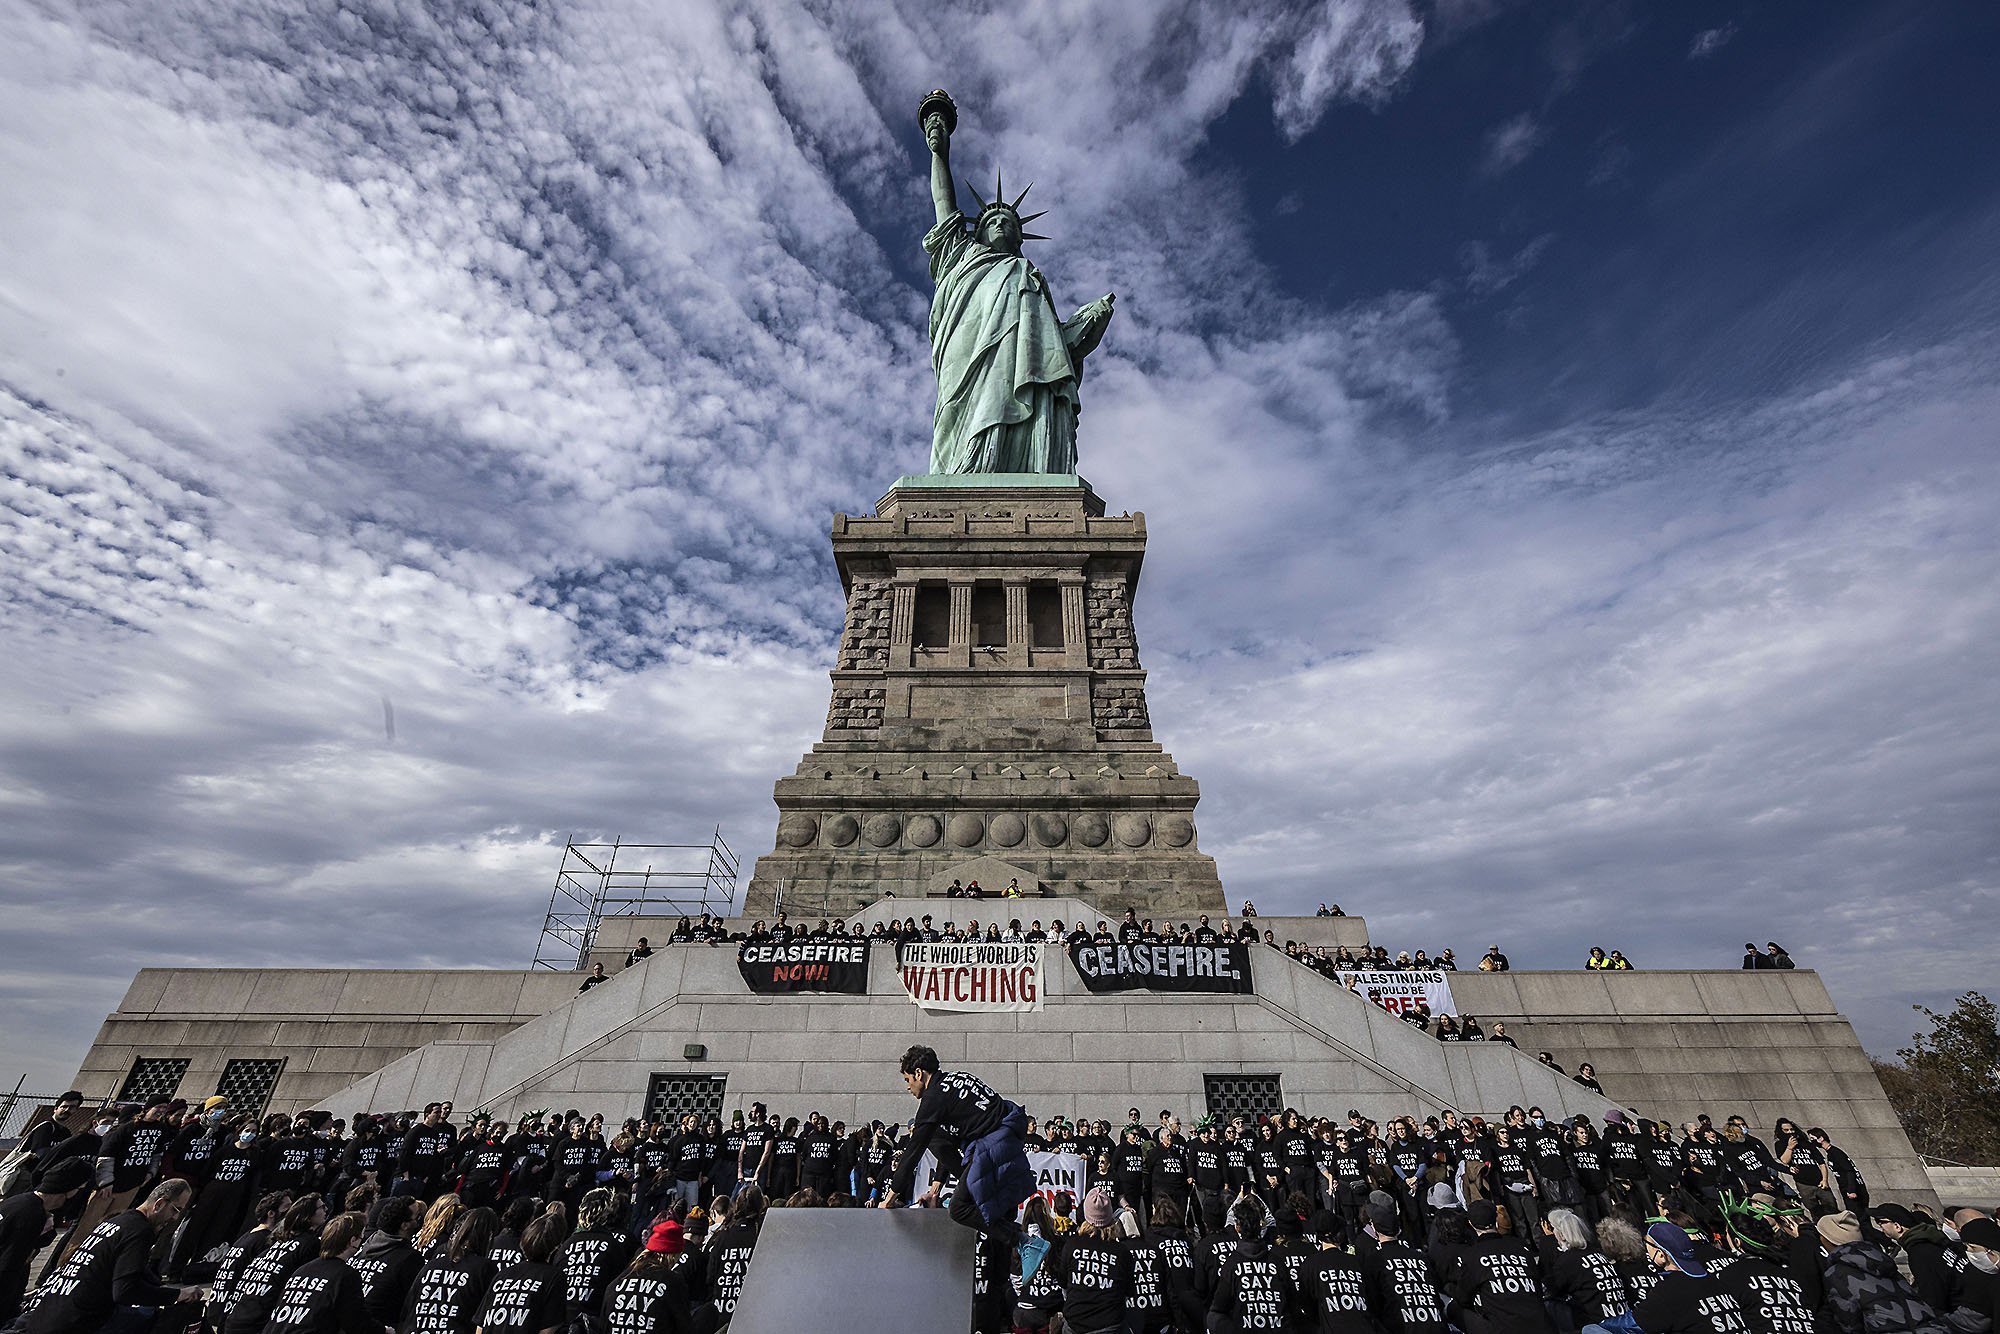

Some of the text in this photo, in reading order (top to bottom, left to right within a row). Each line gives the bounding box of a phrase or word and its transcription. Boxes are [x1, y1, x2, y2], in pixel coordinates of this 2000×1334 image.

[744, 945, 864, 963] CEASEFIRE
[905, 945, 1036, 964] THE WHOLE WORLD IS
[1078, 944, 1241, 980] CEASEFIRE.
[774, 965, 829, 982] NOW!
[1350, 972, 1443, 984] ALESTINIANS
[903, 966, 1036, 1003] WATCHING
[1412, 986, 1424, 994] BE
[133, 1129, 162, 1138] JEWS
[564, 1240, 609, 1255] JEWS
[721, 1248, 752, 1260] JEW
[1211, 1241, 1237, 1254] JEW
[567, 1252, 600, 1265] SAY
[1072, 1249, 1117, 1265] CEASE
[1480, 1255, 1528, 1266] CEASE
[1078, 1260, 1108, 1275] FIRE
[1134, 1260, 1153, 1272] AY
[1234, 1262, 1277, 1276] JEWS
[1386, 1258, 1428, 1271] JEWS
[1492, 1266, 1527, 1277] FIRE
[1592, 1264, 1617, 1279] SAY
[421, 1270, 469, 1287] JEWS
[1072, 1272, 1113, 1289] NOW
[1241, 1275, 1273, 1289] SAY
[1320, 1269, 1363, 1283] CEASE
[1395, 1270, 1426, 1282] SAY
[492, 1278, 542, 1293] CEASE
[615, 1278, 667, 1297] JEWS
[1136, 1284, 1155, 1294] IRE
[1329, 1282, 1359, 1295] FIRE
[1394, 1283, 1436, 1295] CEASE
[1489, 1278, 1536, 1294] NOW
[1748, 1276, 1802, 1293] JEWS
[420, 1285, 457, 1303] SAY
[492, 1293, 528, 1306] FIRE
[566, 1287, 594, 1301] OW
[721, 1287, 741, 1298] FIR
[1238, 1290, 1281, 1302] CEASE
[1760, 1290, 1802, 1306] SAY
[614, 1294, 655, 1313] SAY
[1126, 1294, 1162, 1308] NOW
[1325, 1295, 1367, 1312] NOW
[1404, 1295, 1435, 1306] FIRE
[1247, 1303, 1277, 1314] FIRE
[1401, 1307, 1442, 1322] NOW
[1760, 1306, 1815, 1321] CEASE
[483, 1308, 530, 1327] NOW
[608, 1312, 656, 1330] CEASE
[1242, 1315, 1284, 1328] NOW
[1711, 1312, 1745, 1332] SAY
[1772, 1319, 1814, 1334] FIRE
